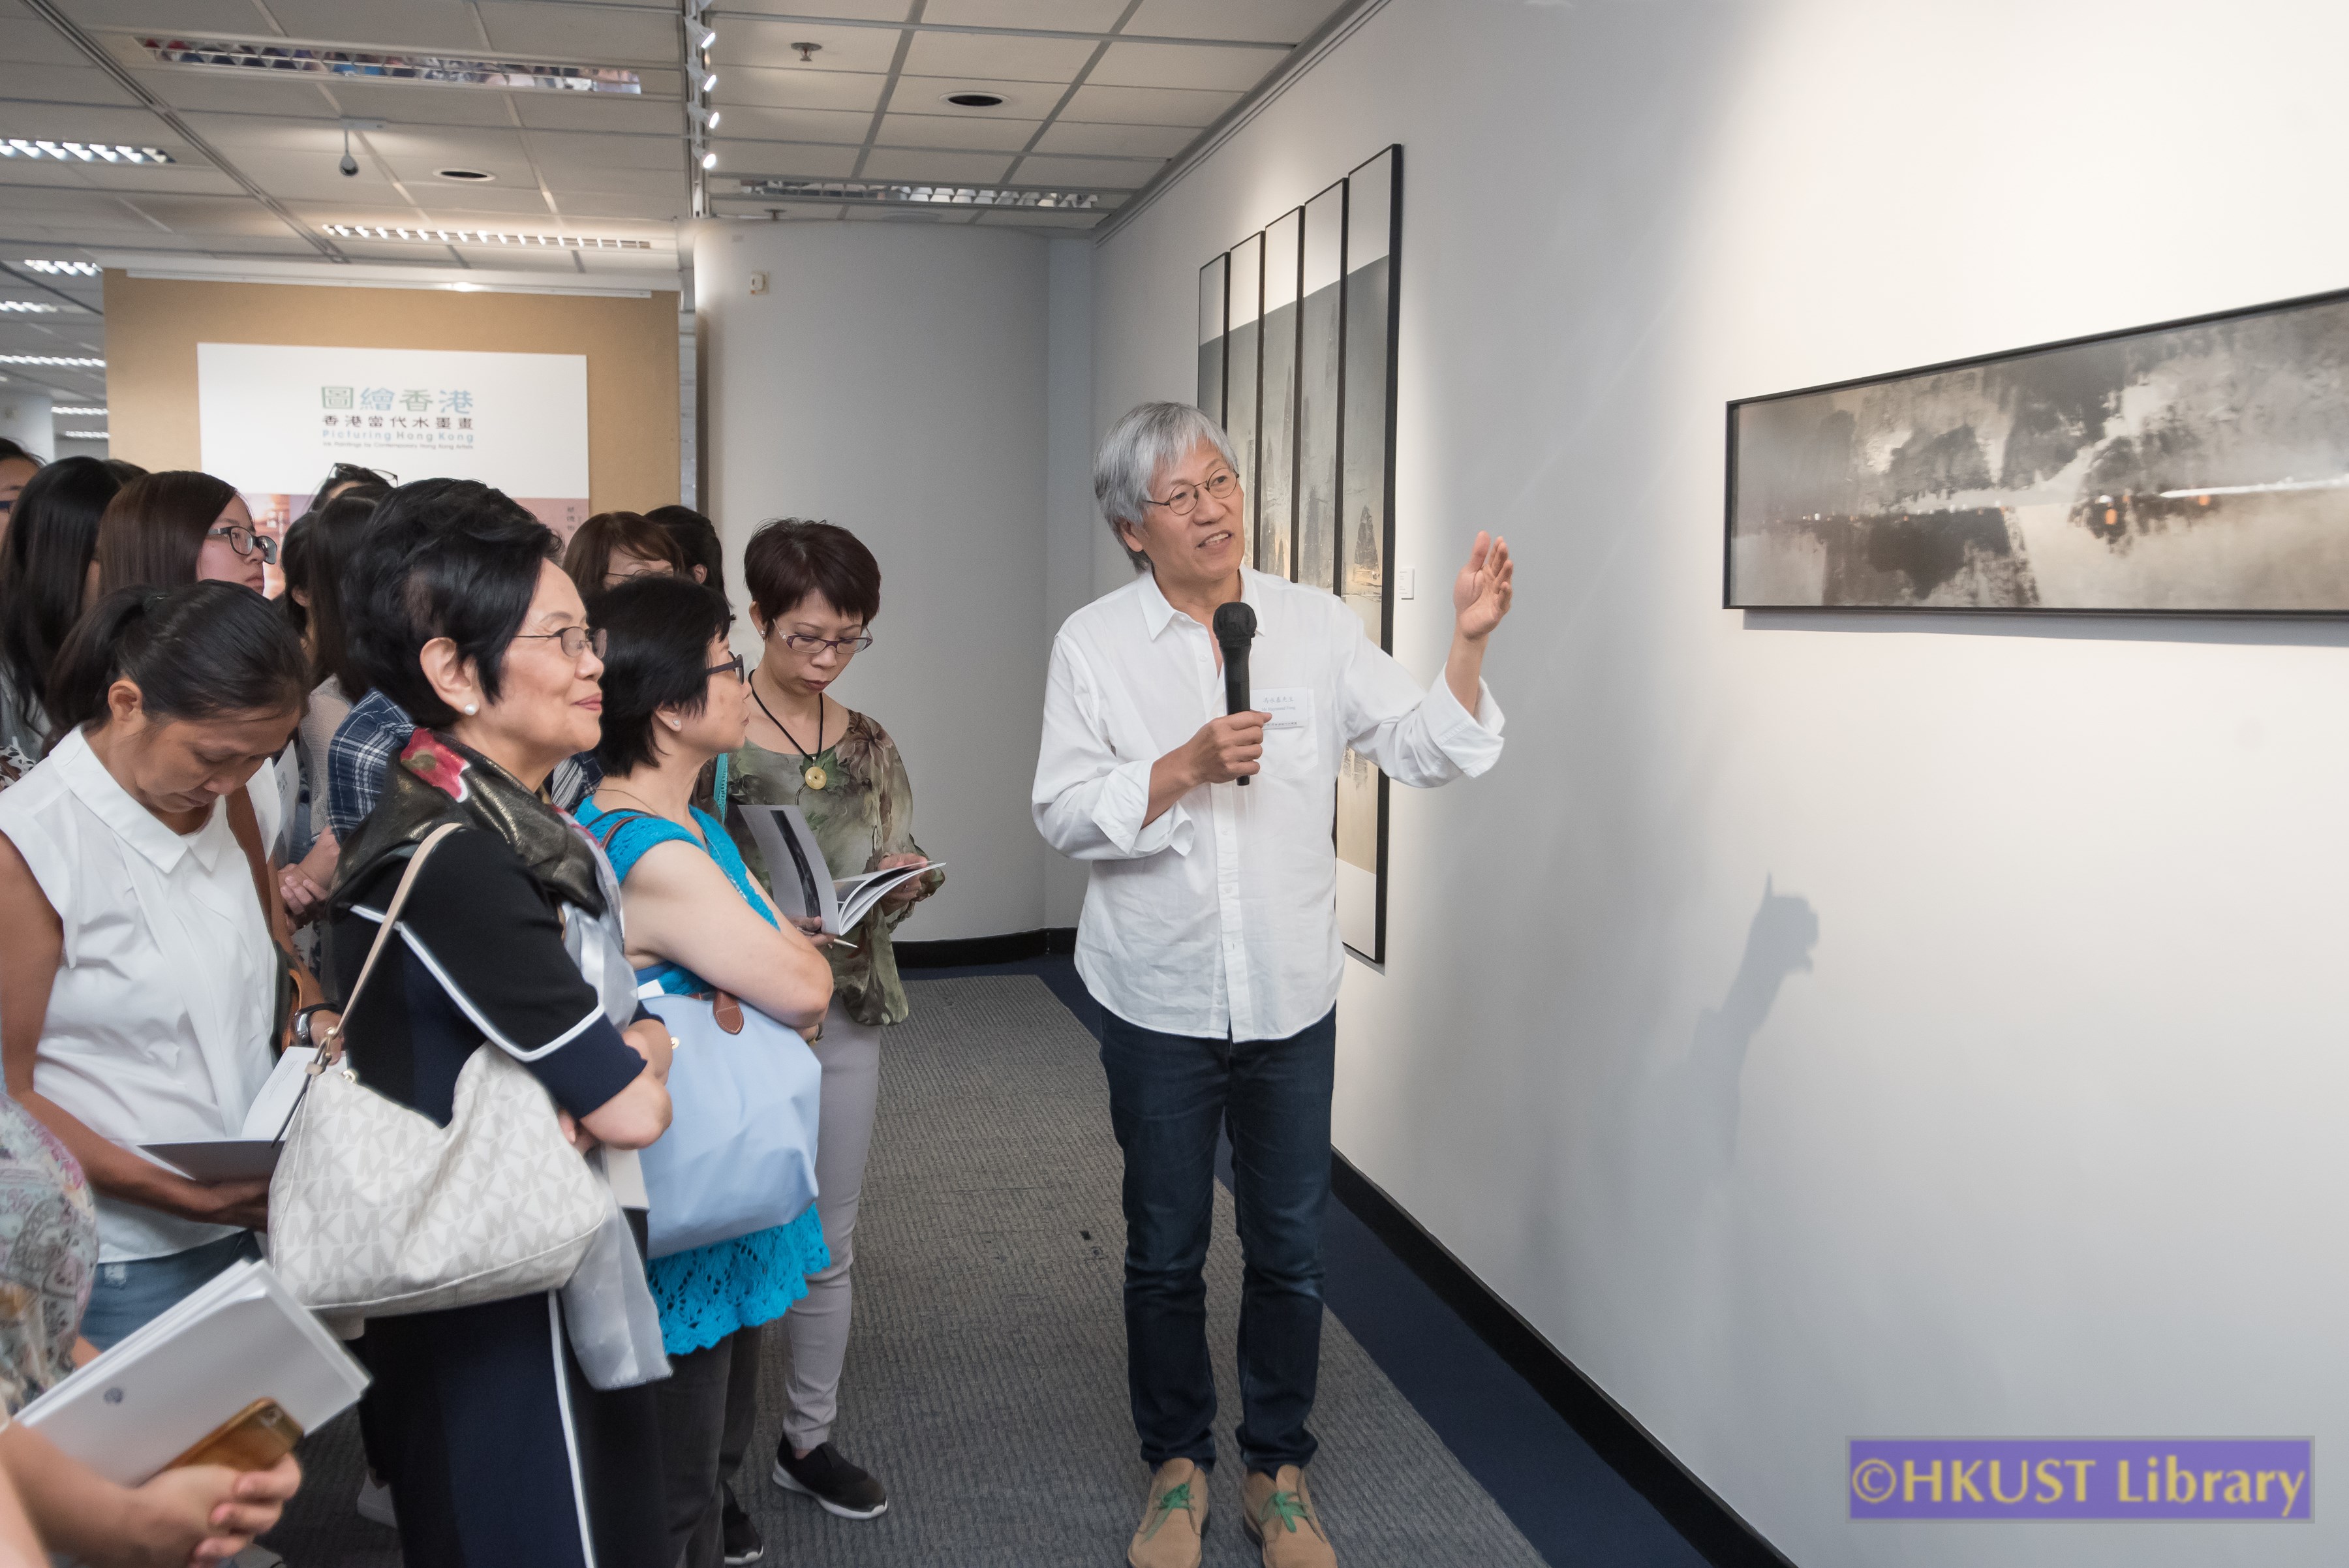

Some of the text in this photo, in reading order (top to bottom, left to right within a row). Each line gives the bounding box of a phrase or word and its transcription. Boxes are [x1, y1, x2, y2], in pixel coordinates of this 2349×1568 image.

[322, 386, 473, 414] 圖繪香港
[322, 415, 473, 429] 香港當代水墨畫
[322, 429, 474, 443] Picturing Hong Kong
